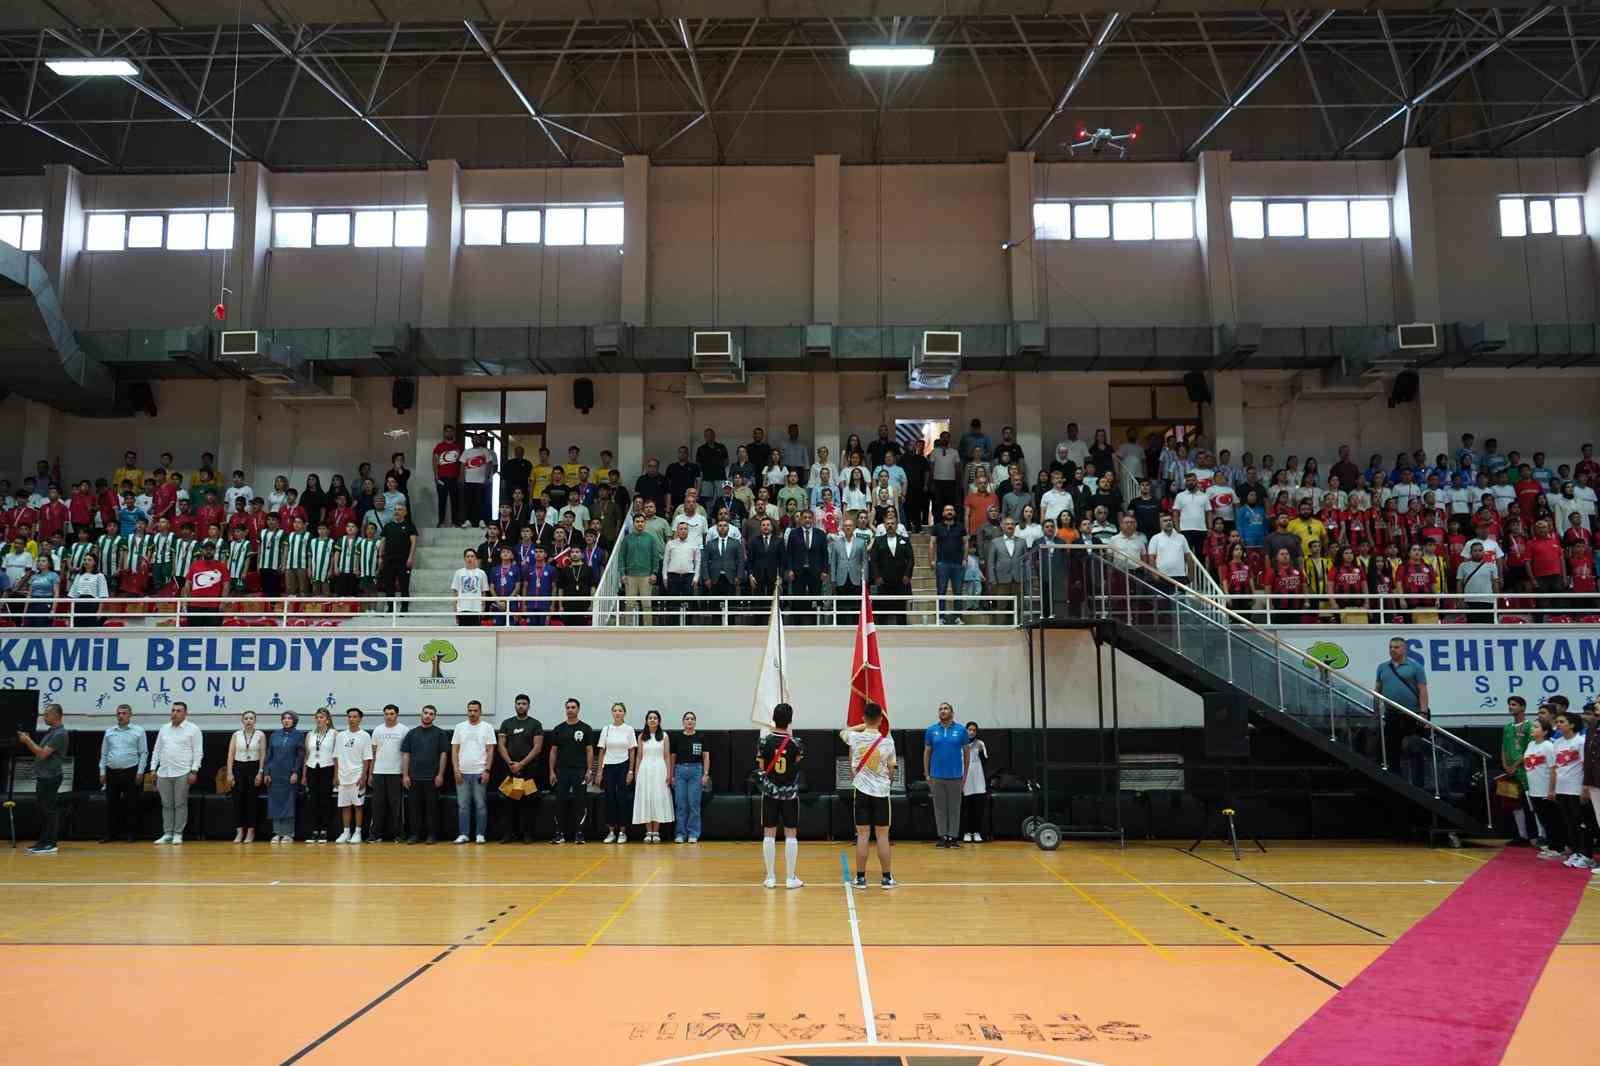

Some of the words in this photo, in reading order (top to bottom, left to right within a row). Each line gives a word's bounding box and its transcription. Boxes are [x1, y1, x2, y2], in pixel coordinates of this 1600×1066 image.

[3, 676, 88, 693] SPOR
[113, 675, 247, 693] SALONU
[1475, 675, 1594, 693] SPOR
